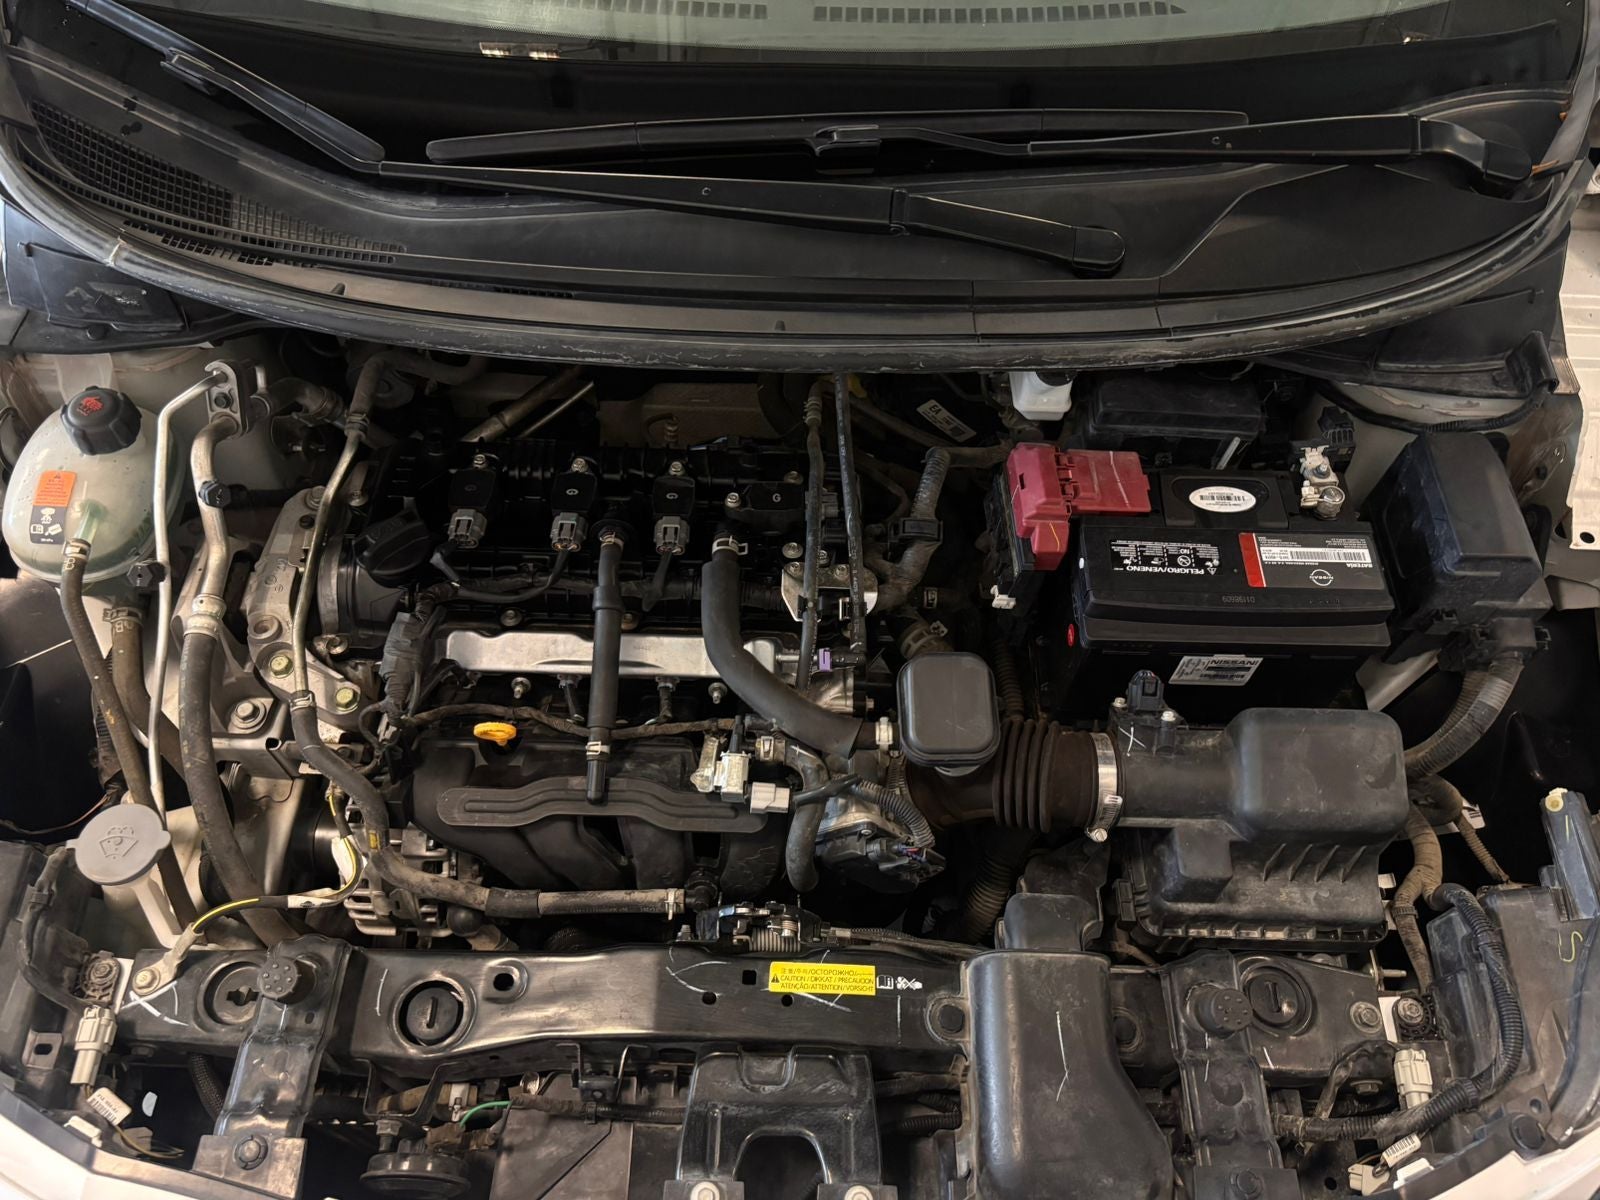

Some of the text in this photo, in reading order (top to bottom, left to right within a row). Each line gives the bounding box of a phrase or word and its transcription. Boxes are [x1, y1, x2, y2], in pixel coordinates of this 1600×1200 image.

[772, 493, 782, 503] G
[1126, 565, 1204, 575] PELIGRO/VENENO
[780, 974, 806, 982] CAUTION
